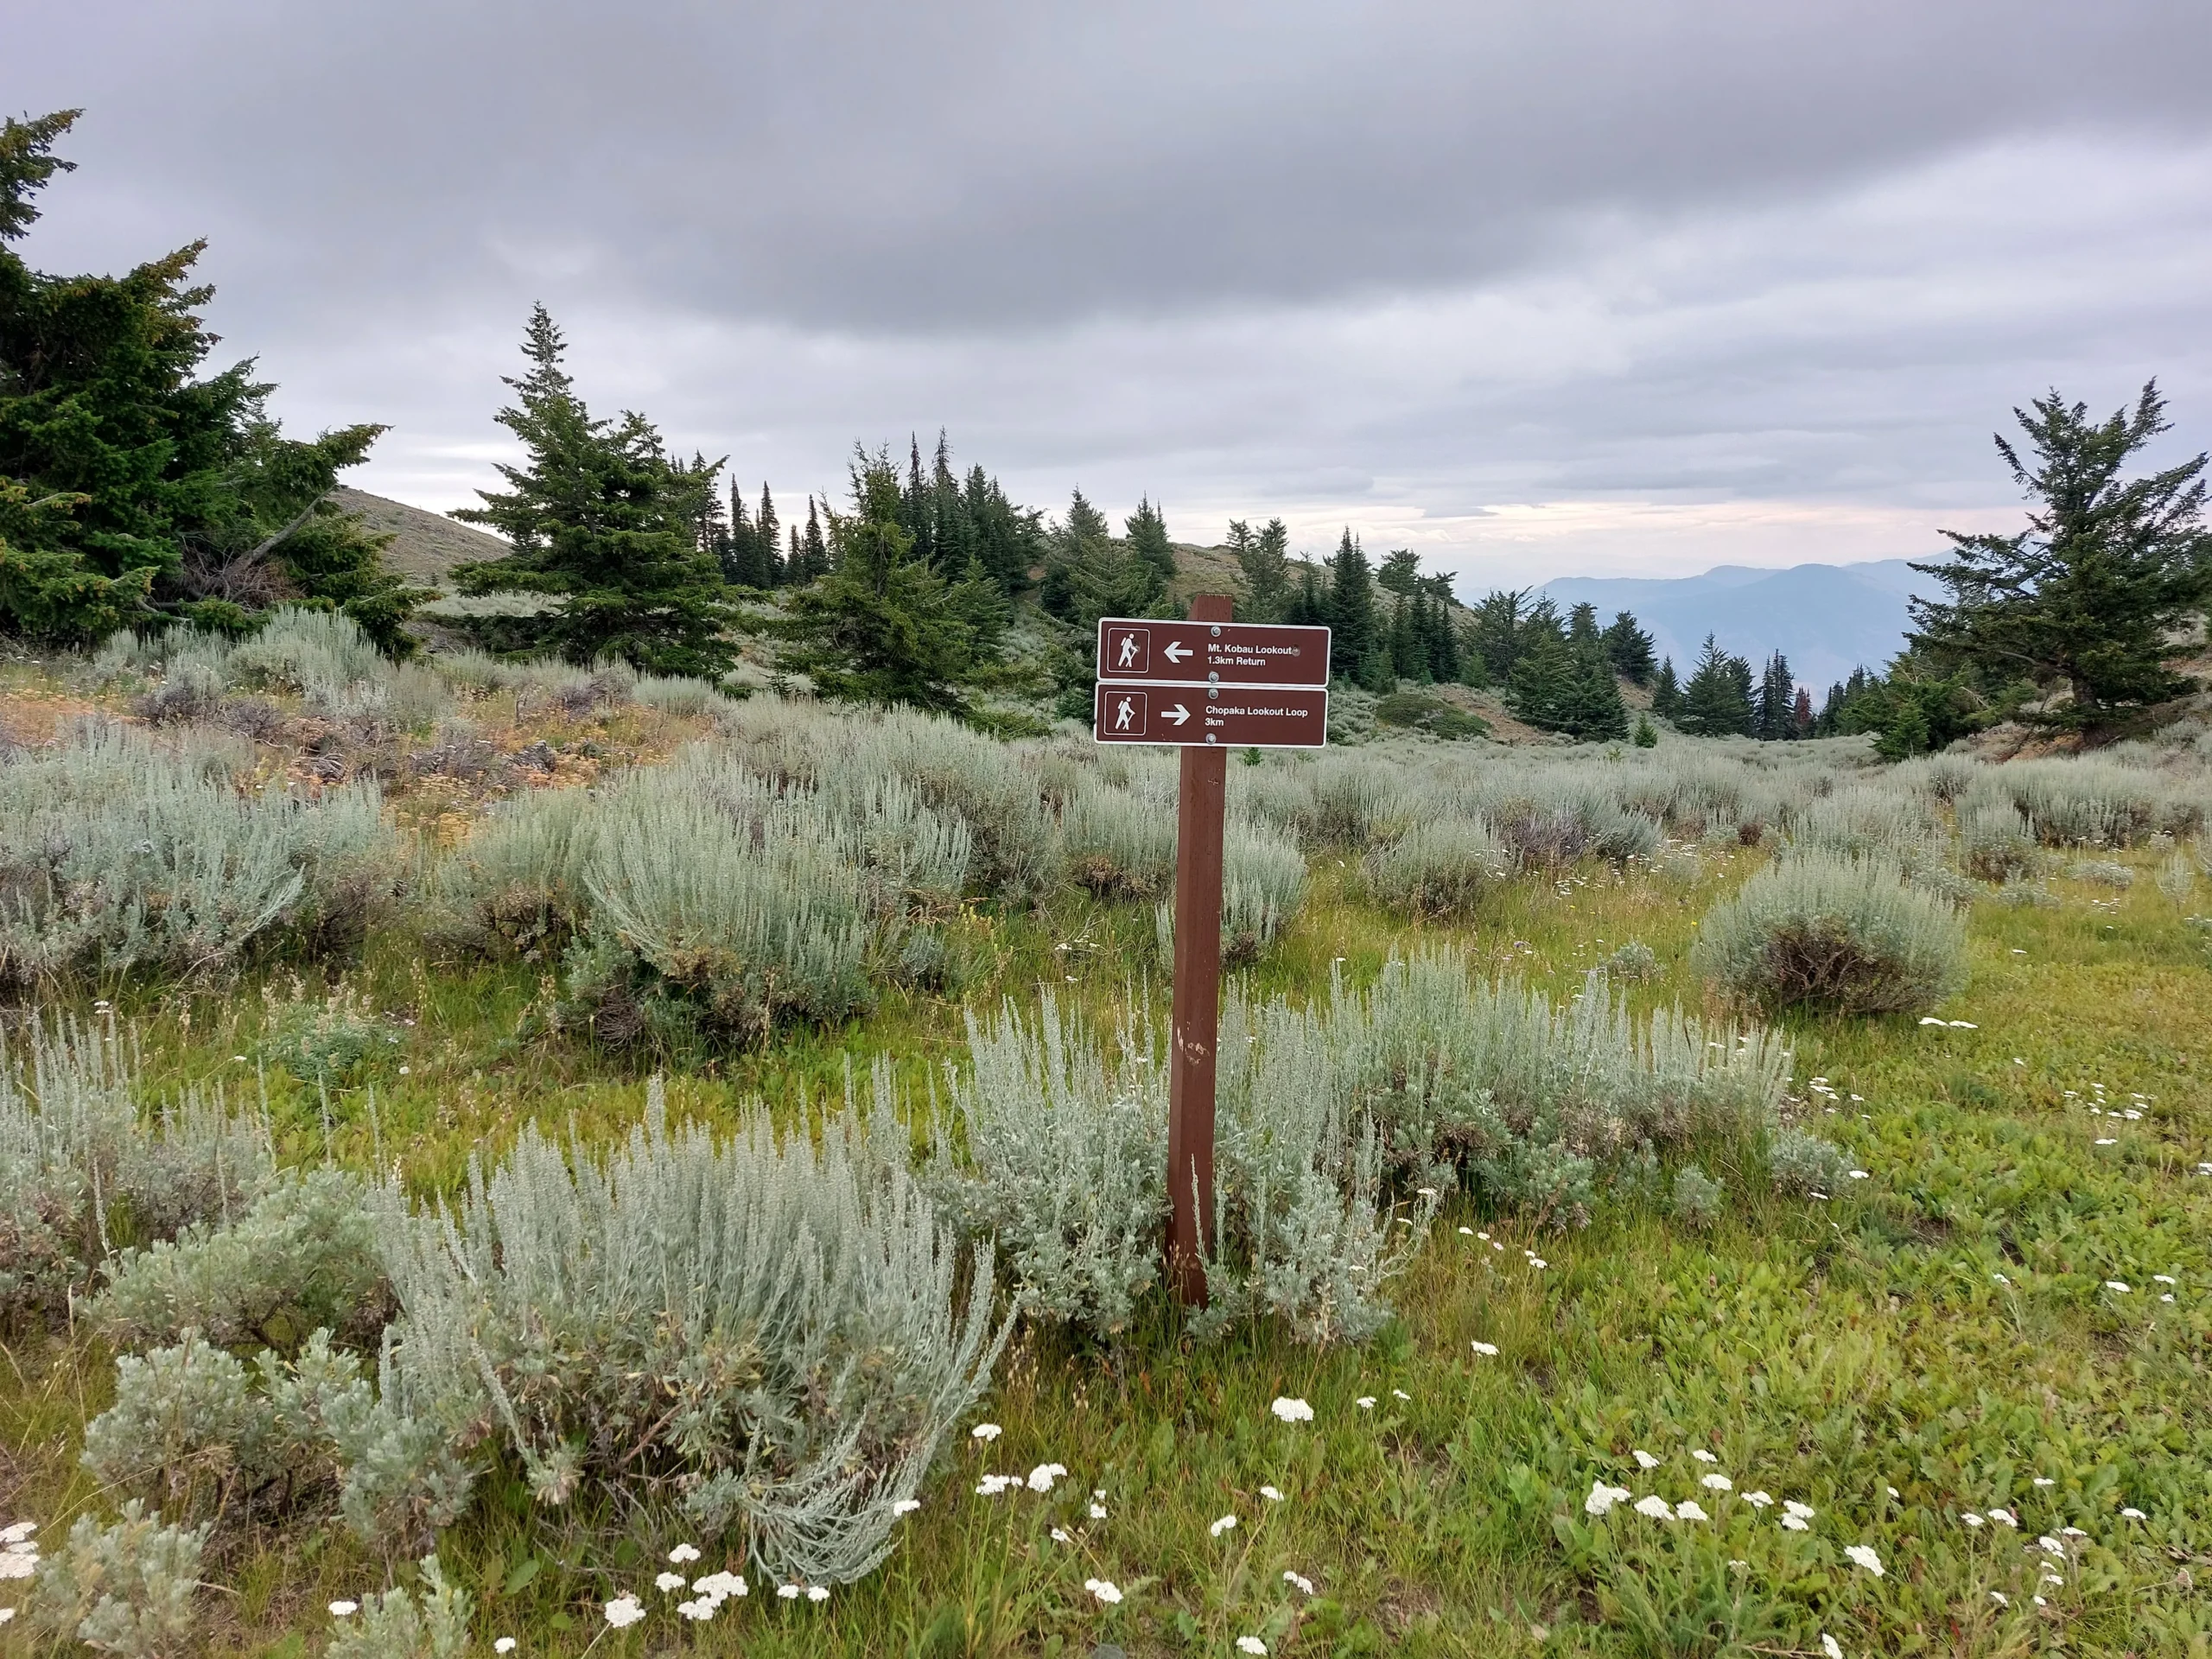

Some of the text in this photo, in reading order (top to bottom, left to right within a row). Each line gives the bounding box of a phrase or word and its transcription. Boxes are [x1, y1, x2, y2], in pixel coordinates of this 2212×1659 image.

[1208, 644, 1292, 655] Mt. Kobau Lookout
[1207, 656, 1266, 666] 1.3km Return
[1205, 705, 1308, 717] Chopaka Lookout Loop
[1205, 717, 1224, 726] 3km
